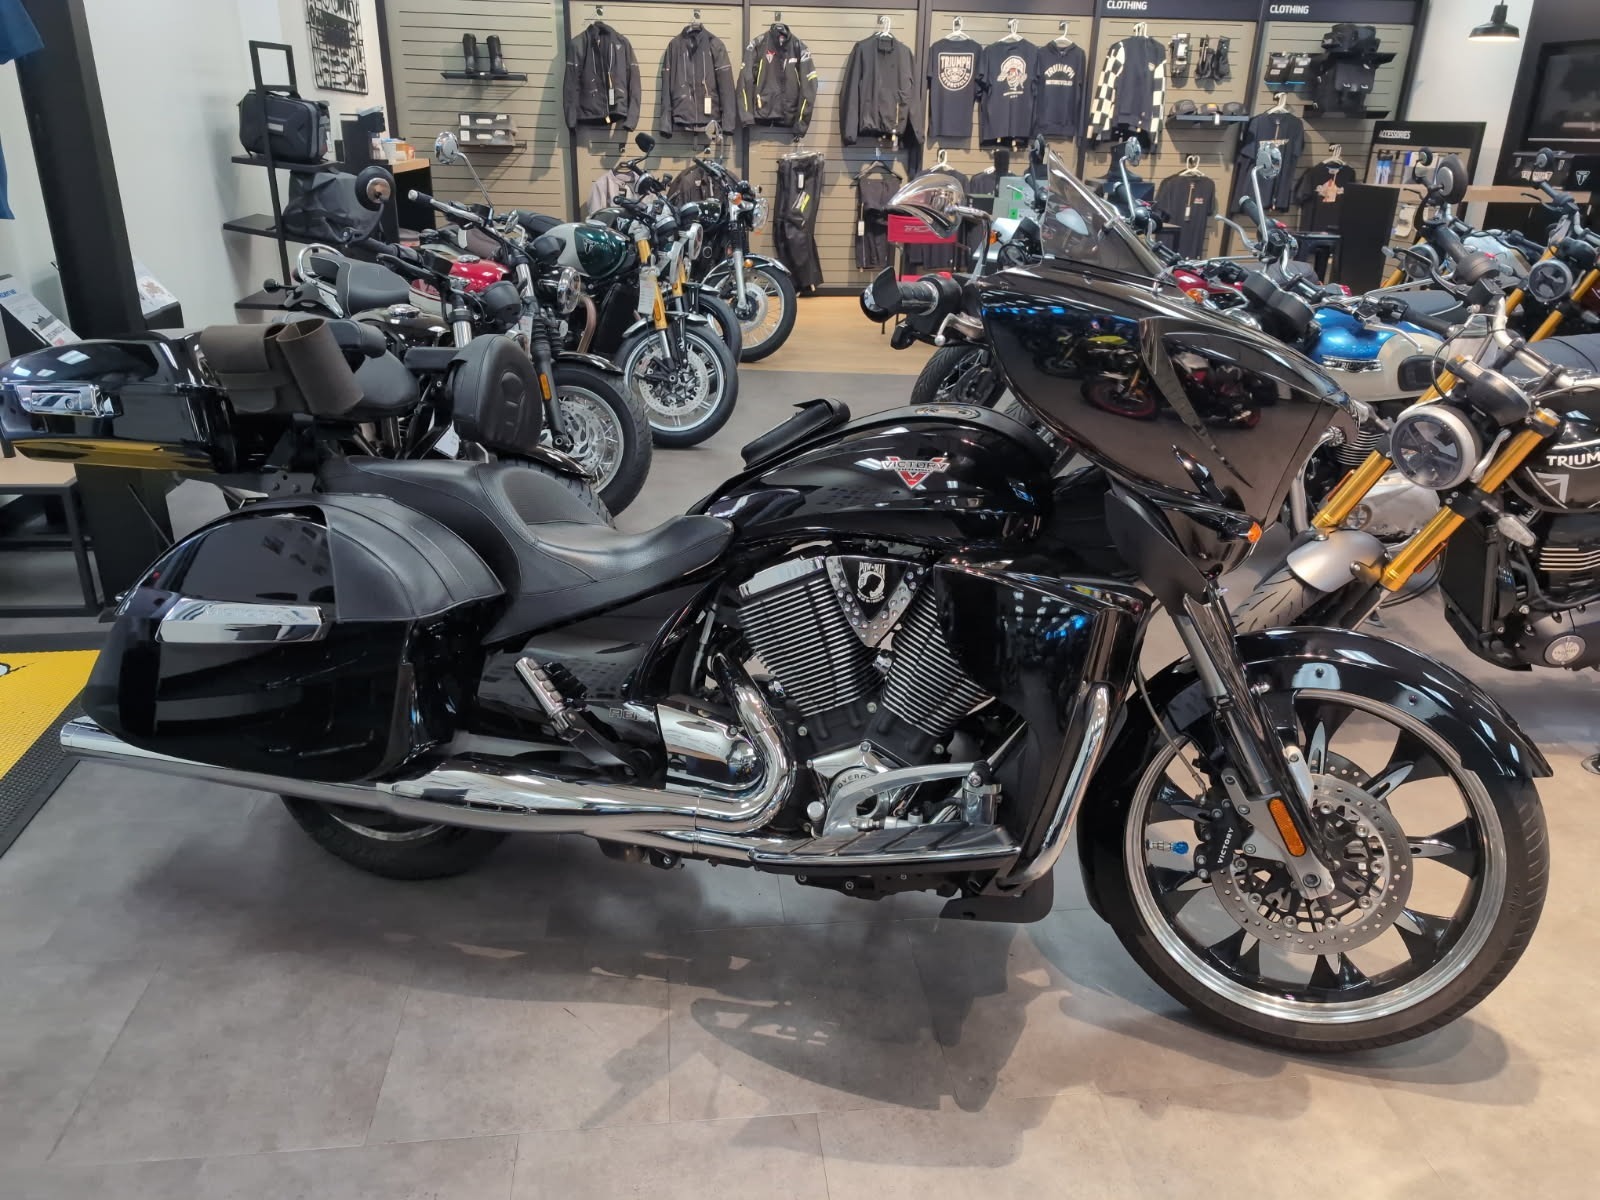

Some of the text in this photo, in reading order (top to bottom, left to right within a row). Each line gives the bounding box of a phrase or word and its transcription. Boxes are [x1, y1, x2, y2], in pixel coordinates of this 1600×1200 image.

[1106, 0, 1148, 10] CLOTHING
[1269, 4, 1310, 15] CLOTHING
[940, 55, 972, 70] TRIUMPH
[1044, 63, 1076, 80] TRIUMPH
[881, 460, 949, 472] VICTORY
[1217, 827, 1234, 864] VICTORY
